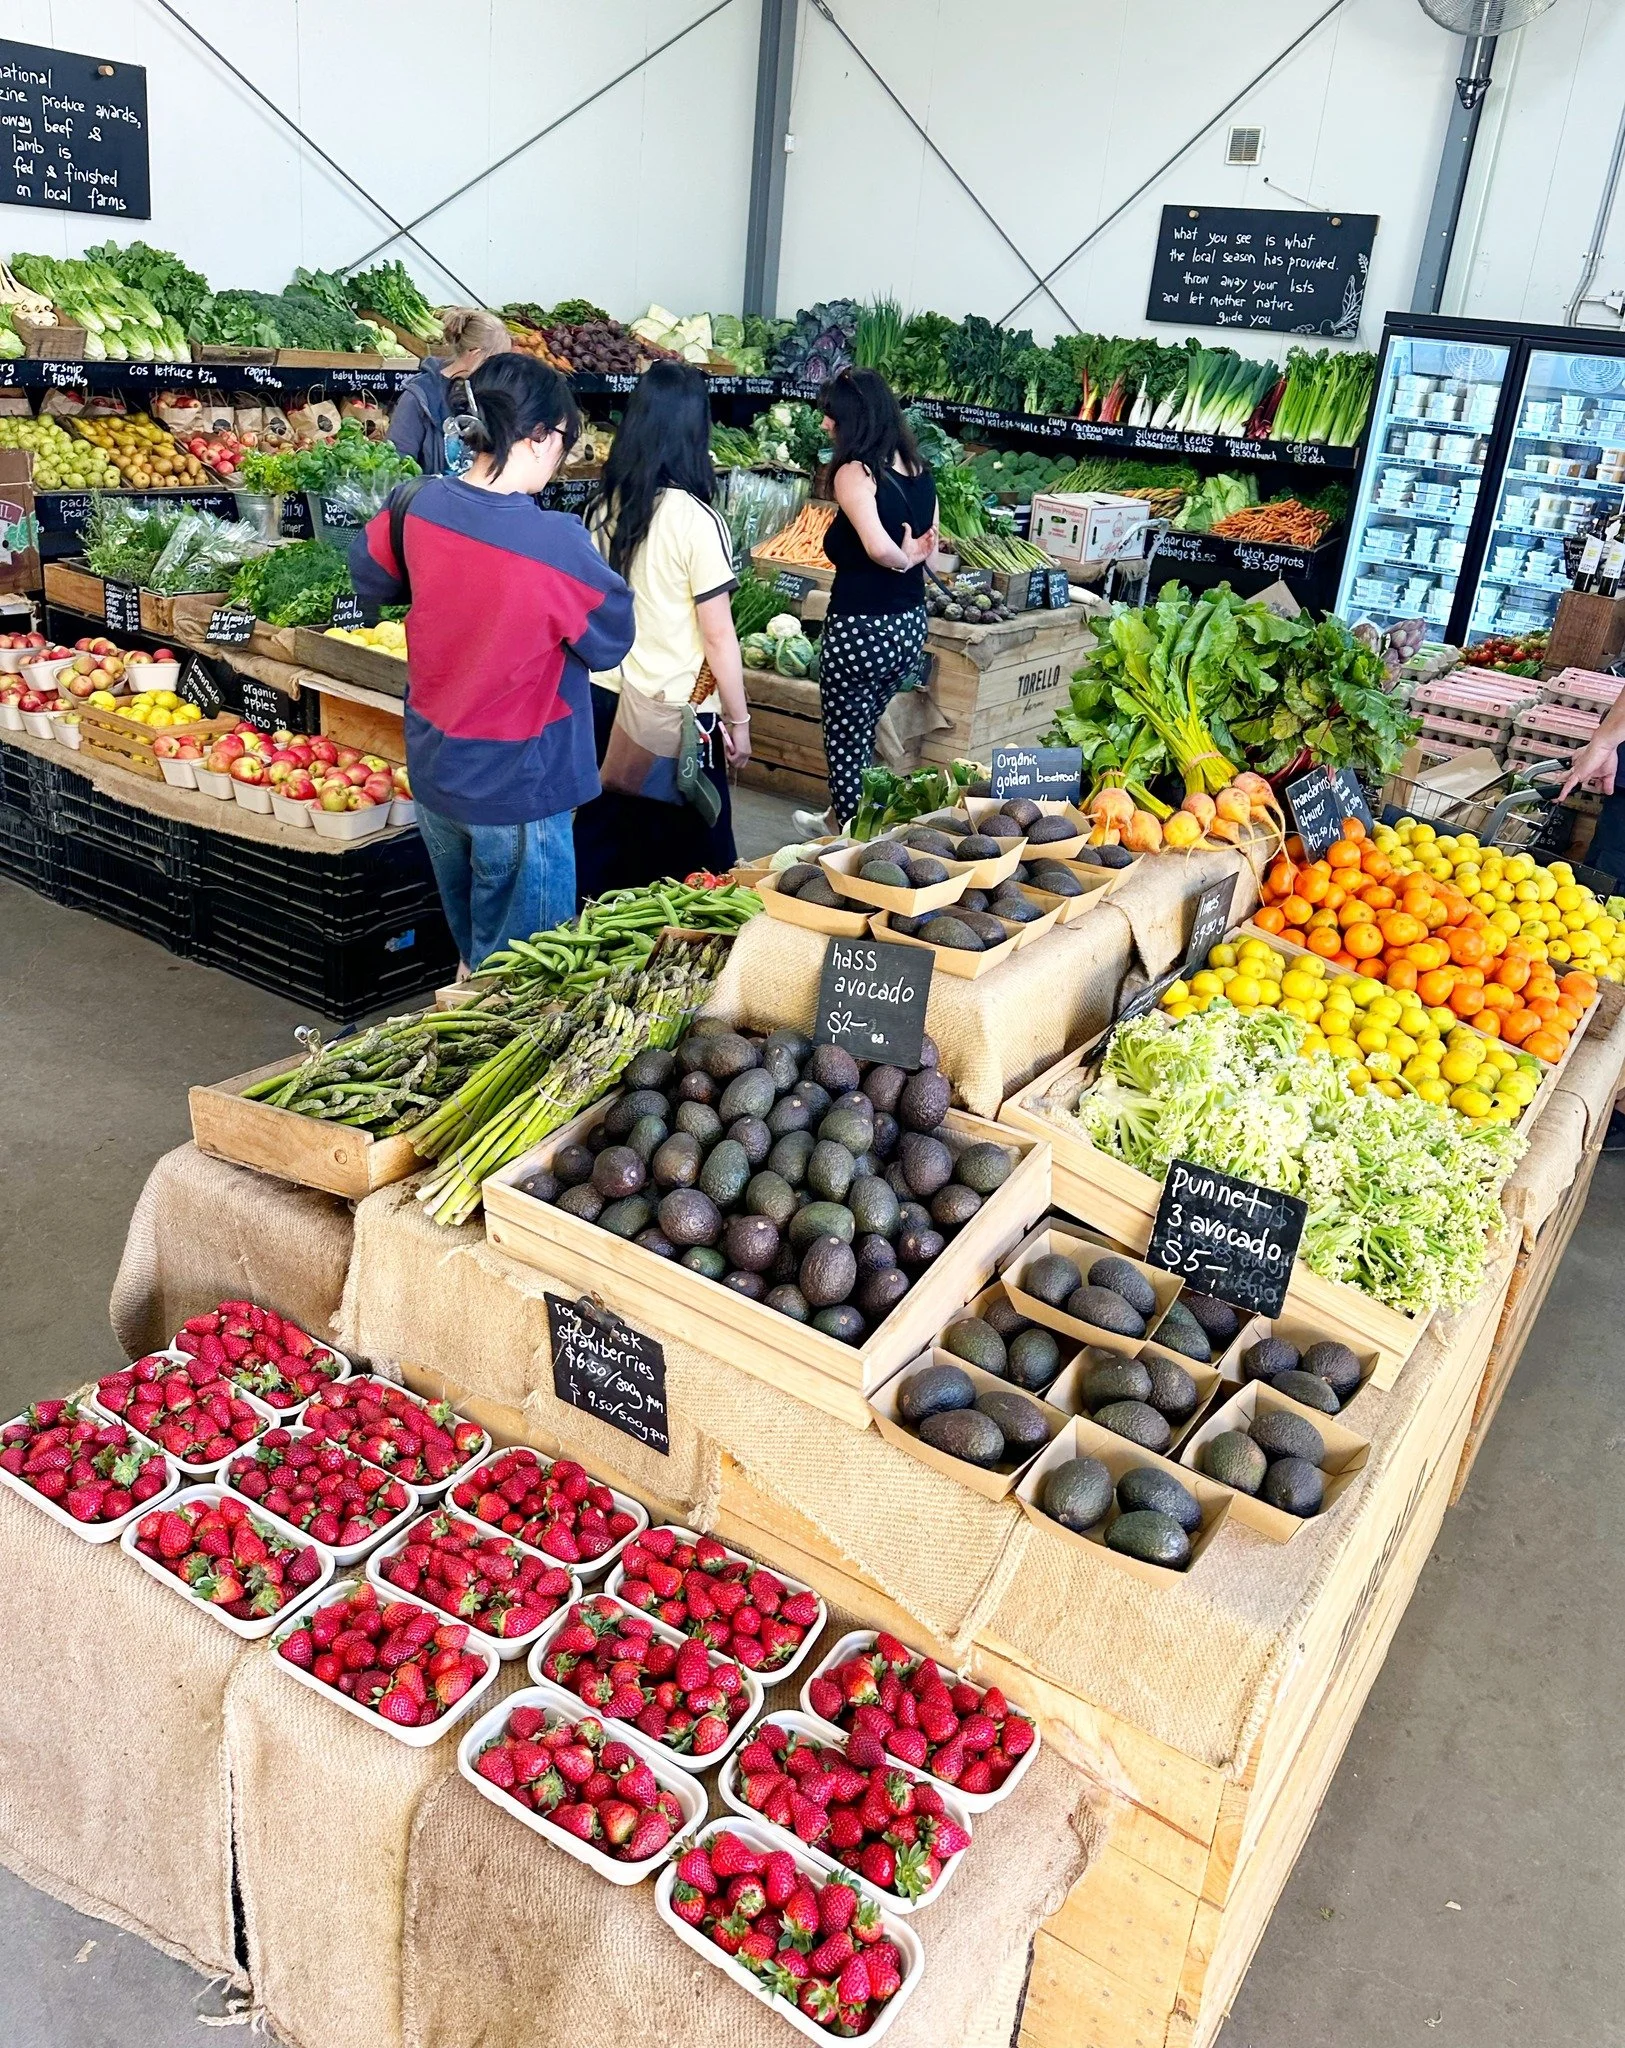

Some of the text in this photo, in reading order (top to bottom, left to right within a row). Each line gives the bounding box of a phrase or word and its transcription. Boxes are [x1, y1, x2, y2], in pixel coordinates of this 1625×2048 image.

[42, 95, 86, 114] produce
[96, 104, 142, 129] awards,
[2, 115, 102, 141] oway beef &
[13, 134, 72, 159] lamb is
[13, 156, 118, 187] fed & finished
[17, 182, 127, 211] on local farms
[1205, 229, 1228, 246] you
[1236, 233, 1252, 244] see
[1265, 234, 1276, 246] is
[1284, 233, 1316, 250] what
[1169, 248, 1339, 275] the local season has provided.
[1183, 271, 1315, 295] throw away your lists
[1162, 291, 1295, 313] and let mother nature
[1216, 311, 1243, 325] guide
[42, 362, 84, 376] parsnip
[129, 365, 148, 376] cos
[154, 364, 193, 379] lettuce
[244, 366, 271, 379] rapini
[332, 370, 386, 381] baby broccoli
[1071, 423, 1124, 437] rainbow chard
[1225, 438, 1261, 452] rhubarb
[1256, 450, 1277, 460] bunch
[60, 497, 91, 513] pack
[1182, 537, 1202, 551] loaf
[1233, 543, 1304, 568] dutch carrots
[336, 595, 358, 610] local
[186, 671, 209, 707] lemons
[191, 657, 220, 704] lemonade
[243, 683, 278, 701] organic
[1017, 664, 1061, 698] TORELLO
[243, 695, 277, 713] apples
[997, 752, 1037, 774] Organic
[996, 767, 1080, 796] golden beetroot
[832, 942, 877, 972] hass
[834, 976, 915, 1004] avocado
[1167, 1203, 1282, 1261] 3 avocado
[556, 1321, 655, 1381] strawberries
